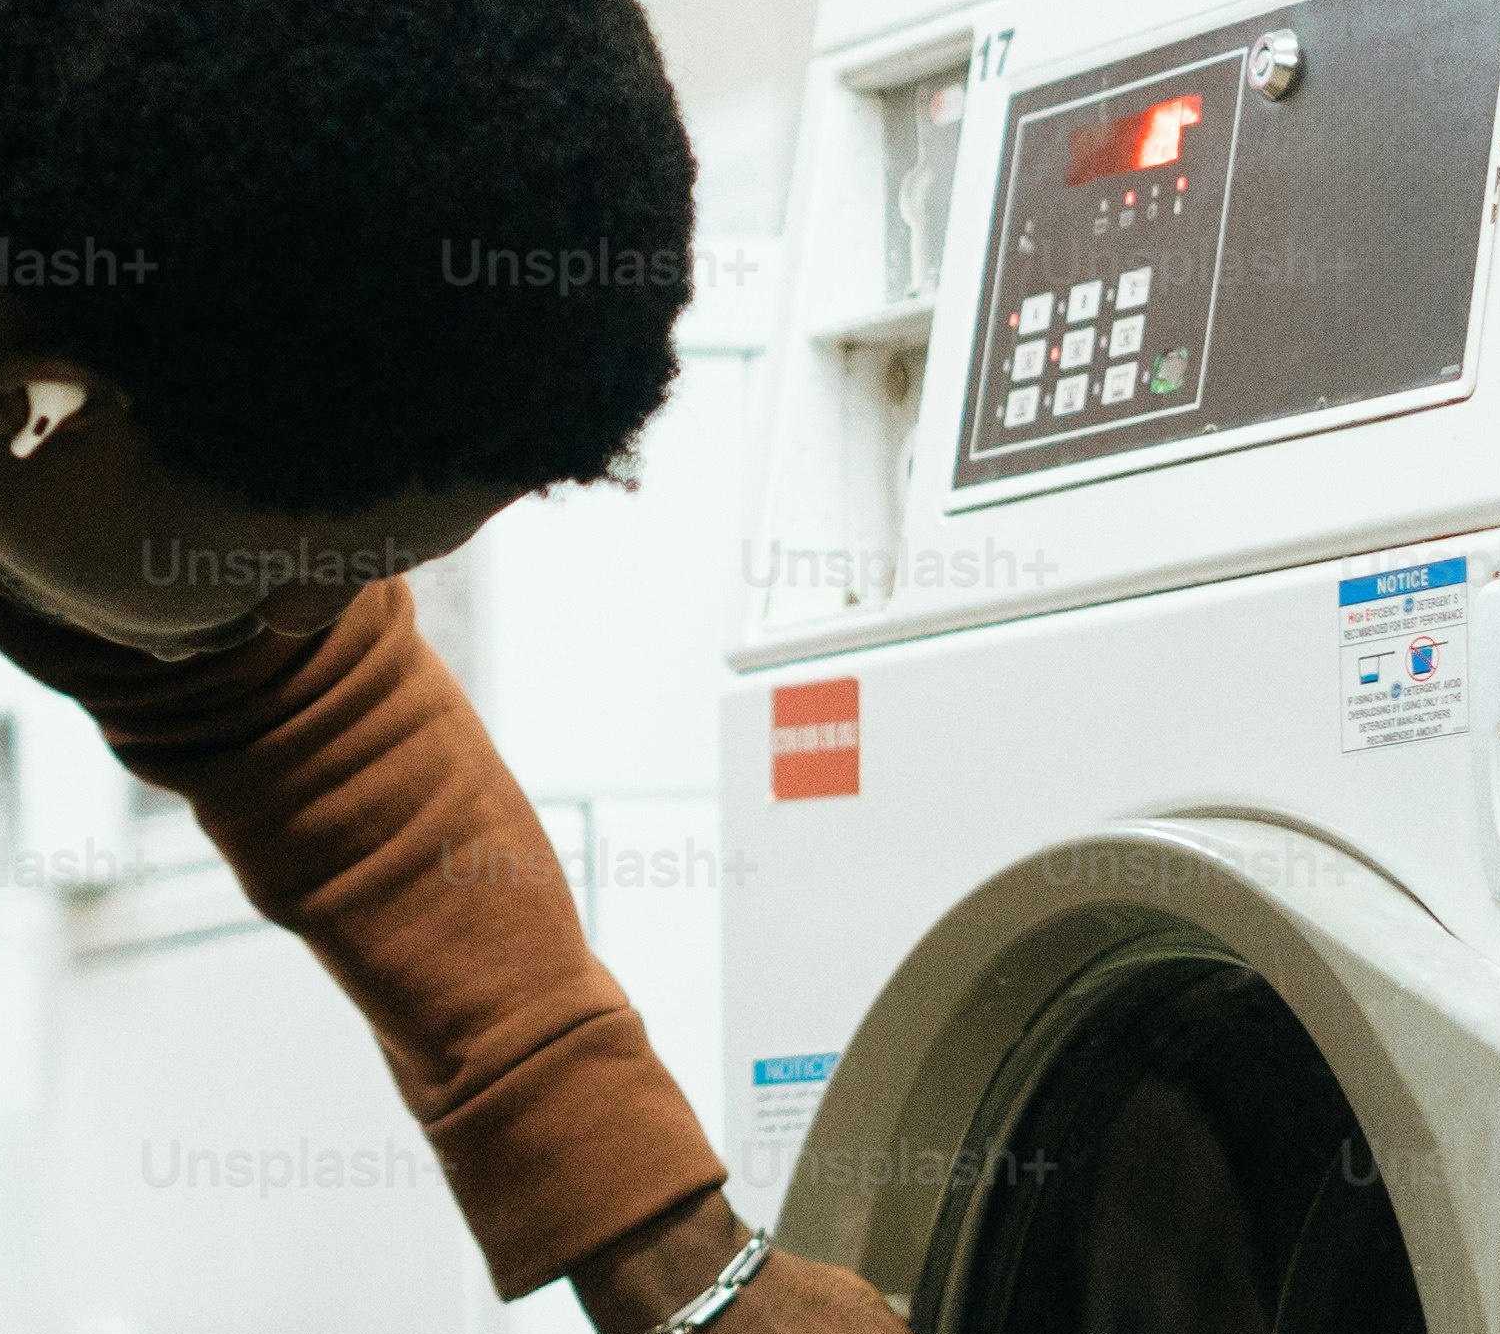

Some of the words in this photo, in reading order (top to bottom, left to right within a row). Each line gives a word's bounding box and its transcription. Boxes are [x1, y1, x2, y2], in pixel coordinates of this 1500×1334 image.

[976, 28, 1016, 82] 17
[1377, 568, 1429, 595] NOTICE
[1416, 594, 1451, 612] DETERGENT
[1343, 622, 1388, 640] RECOMMENDED
[1389, 620, 1401, 632] FOR
[1402, 616, 1418, 630] BEST
[1419, 607, 1464, 626] PERFORMANCE
[1359, 717, 1396, 733] DETERGENT
[1366, 729, 1414, 746] RECOMMENDED
